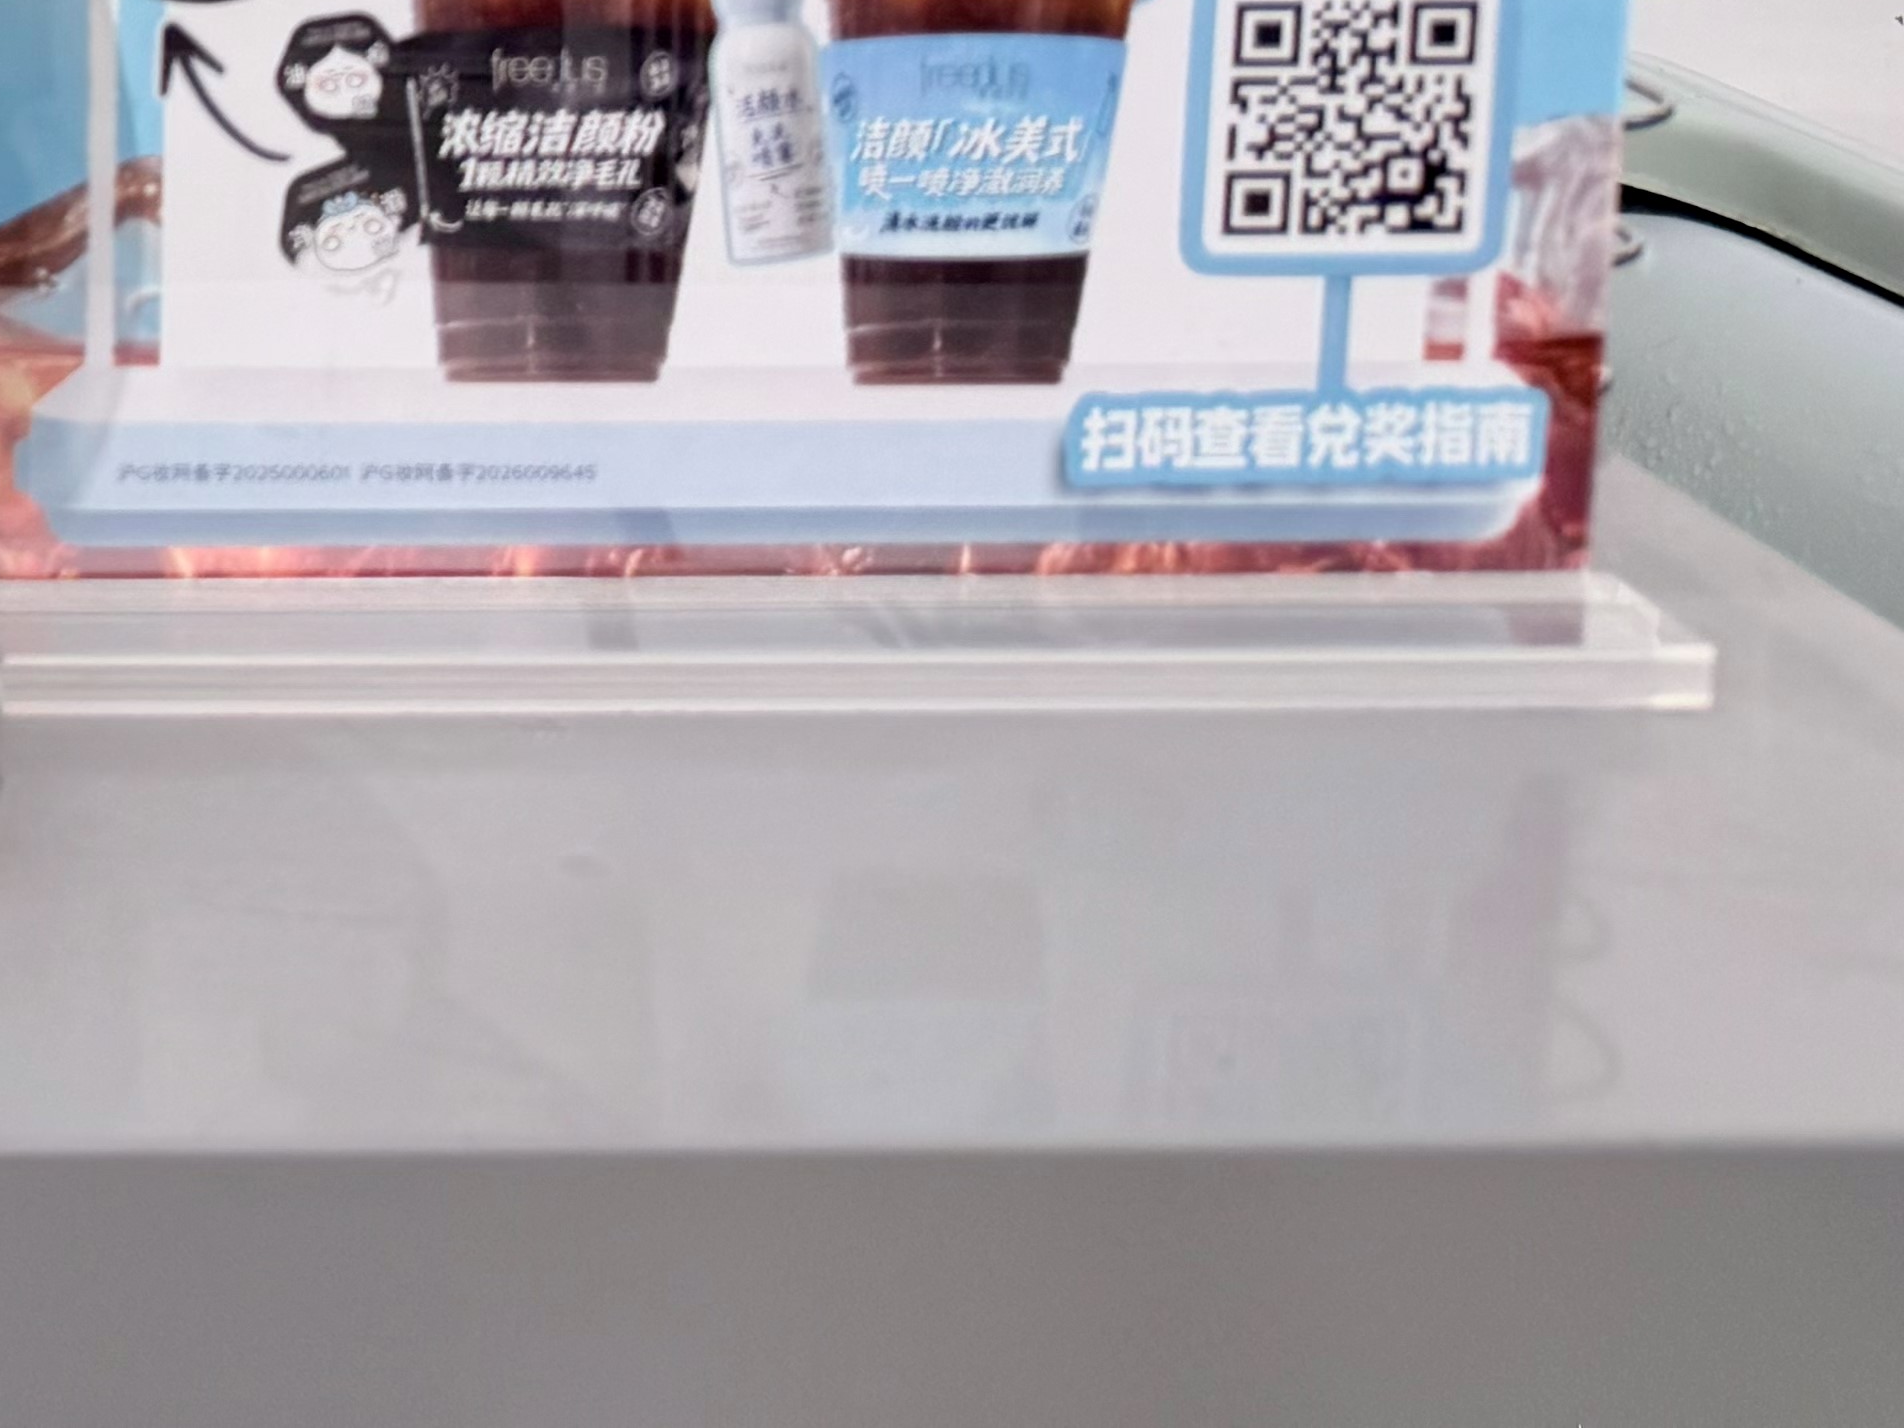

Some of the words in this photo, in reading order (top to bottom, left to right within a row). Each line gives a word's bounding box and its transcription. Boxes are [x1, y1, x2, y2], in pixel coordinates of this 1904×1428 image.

[437, 107, 667, 158] 浓缩洁颜粉
[1080, 402, 1535, 473] 扫码查看兑奖指南
